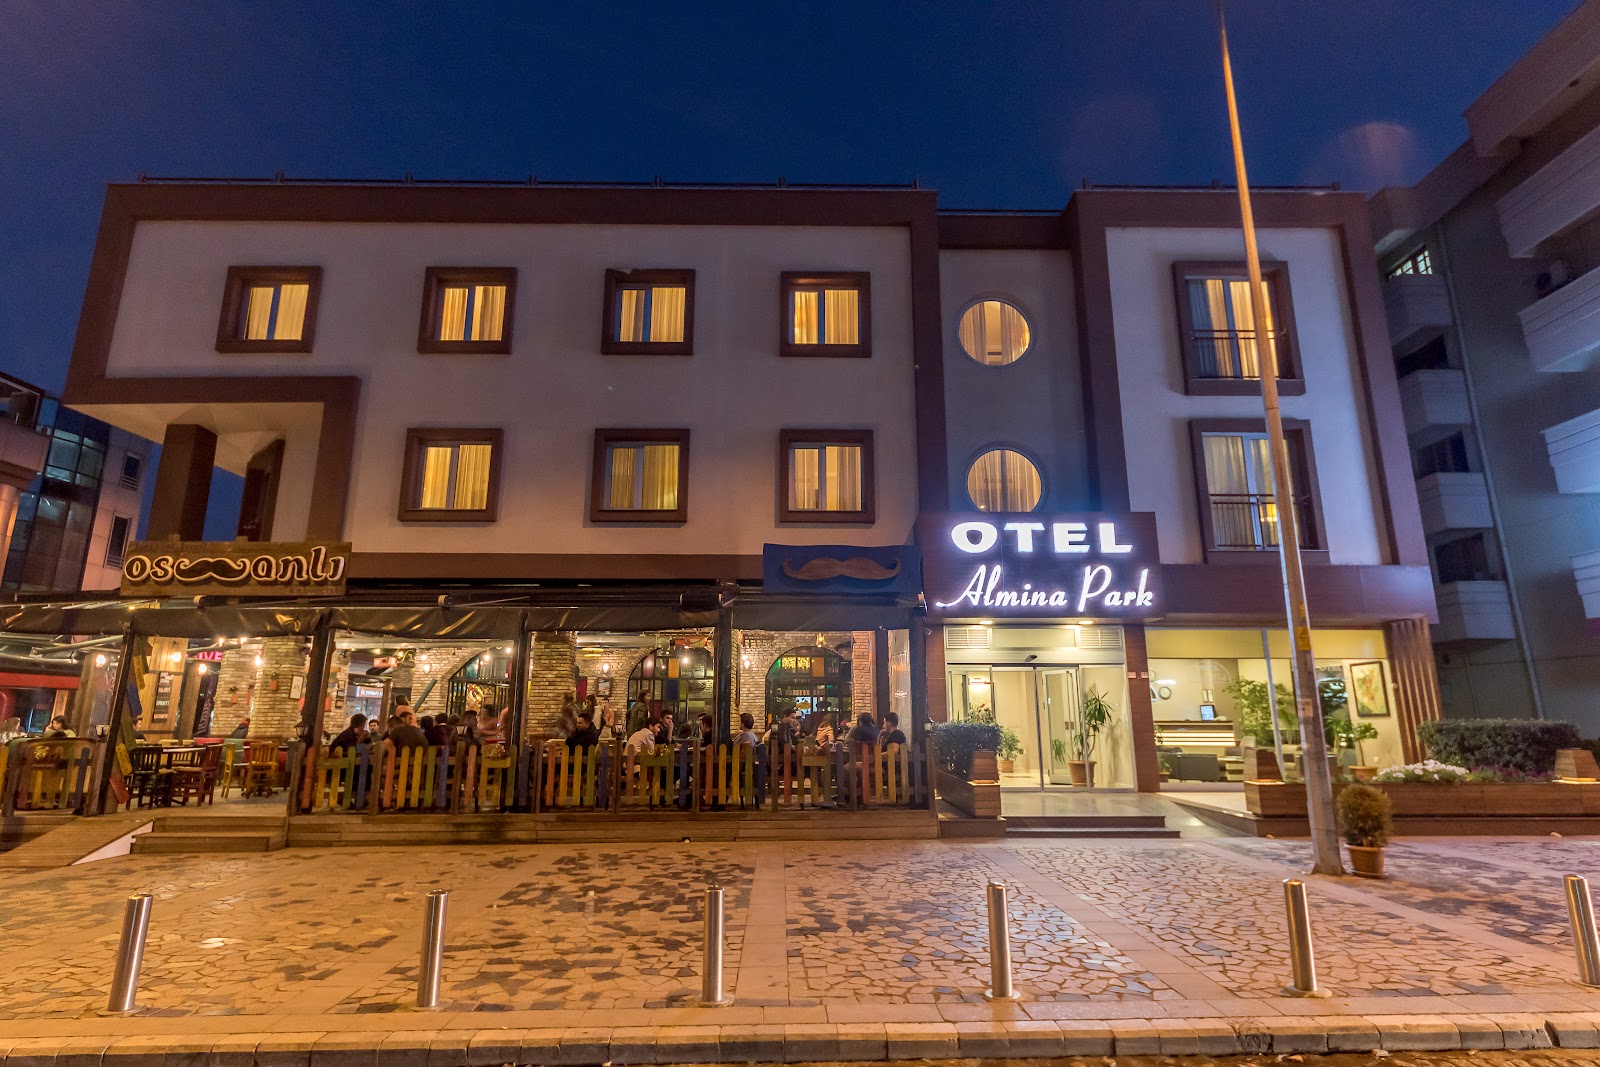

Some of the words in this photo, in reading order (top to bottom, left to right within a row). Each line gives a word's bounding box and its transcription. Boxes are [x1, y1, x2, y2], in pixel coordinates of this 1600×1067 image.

[950, 521, 1133, 554] OTEL
[935, 564, 1067, 608] Almina
[1077, 564, 1154, 613] Park
